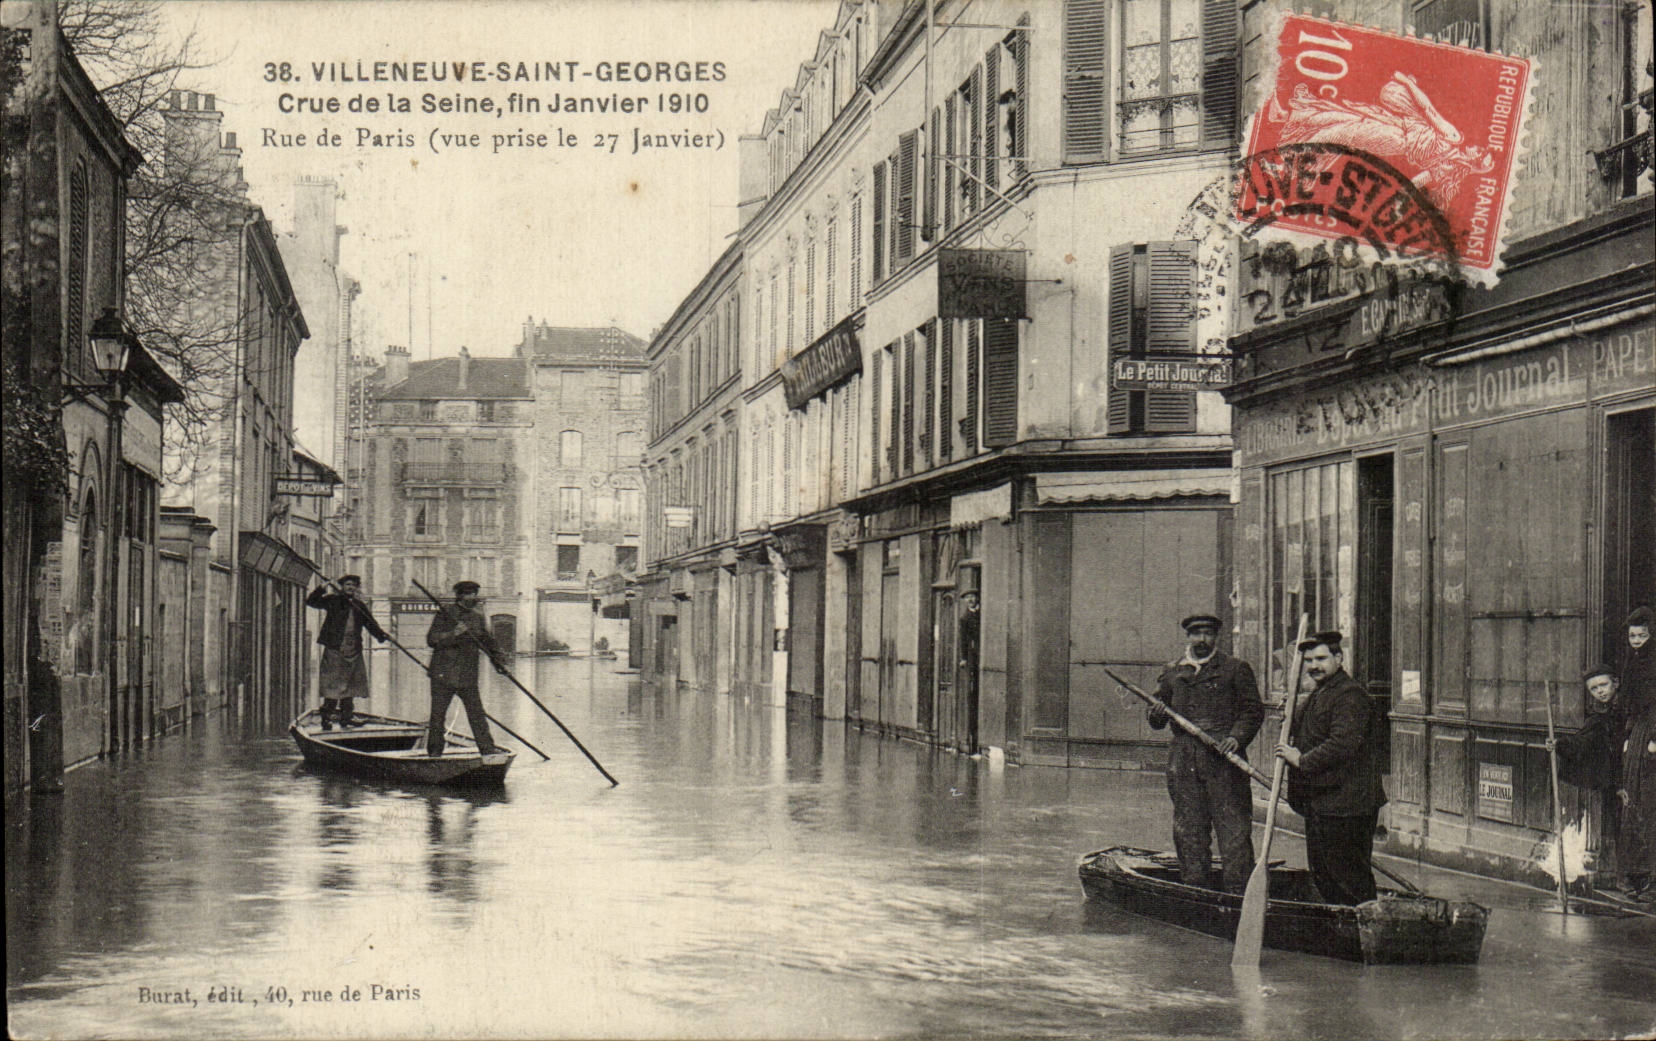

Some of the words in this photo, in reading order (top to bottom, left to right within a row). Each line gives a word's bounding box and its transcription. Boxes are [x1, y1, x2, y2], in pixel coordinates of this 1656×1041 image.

[1295, 30, 1353, 81] 10
[1487, 64, 1519, 152] REPUBLIQUE
[1466, 176, 1497, 257] FRANÇAISE
[1117, 362, 1135, 380] Le
[1138, 362, 1169, 381] Petit
[1466, 344, 1571, 415] Journal
[1487, 785, 1512, 800] JOURNAL
